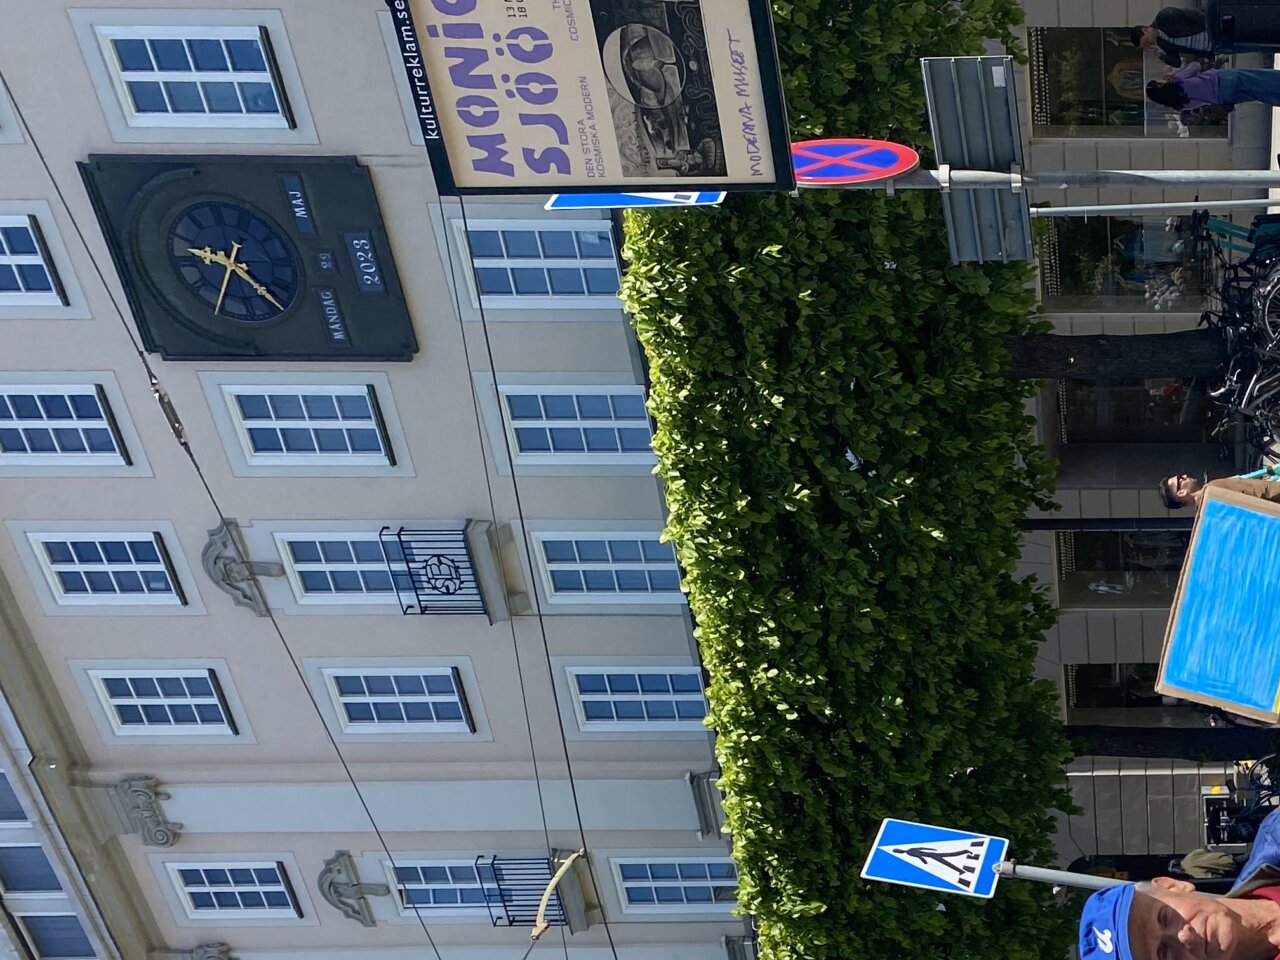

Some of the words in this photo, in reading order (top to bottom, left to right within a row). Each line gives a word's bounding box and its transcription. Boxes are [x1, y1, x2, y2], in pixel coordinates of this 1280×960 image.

[506, 6, 517, 19] 13
[518, 6, 528, 19] 18
[393, 0, 440, 140] kulturreklam.se
[726, 28, 750, 98] MUSEET
[492, 26, 572, 176] SJÖÖ
[579, 76, 595, 120] MODERN
[576, 118, 592, 155] STORA
[589, 123, 606, 178] KOSMISKA
[585, 158, 596, 178] DEN
[288, 190, 308, 219] MAJ
[319, 252, 332, 270] 29
[352, 238, 381, 285] 2023
